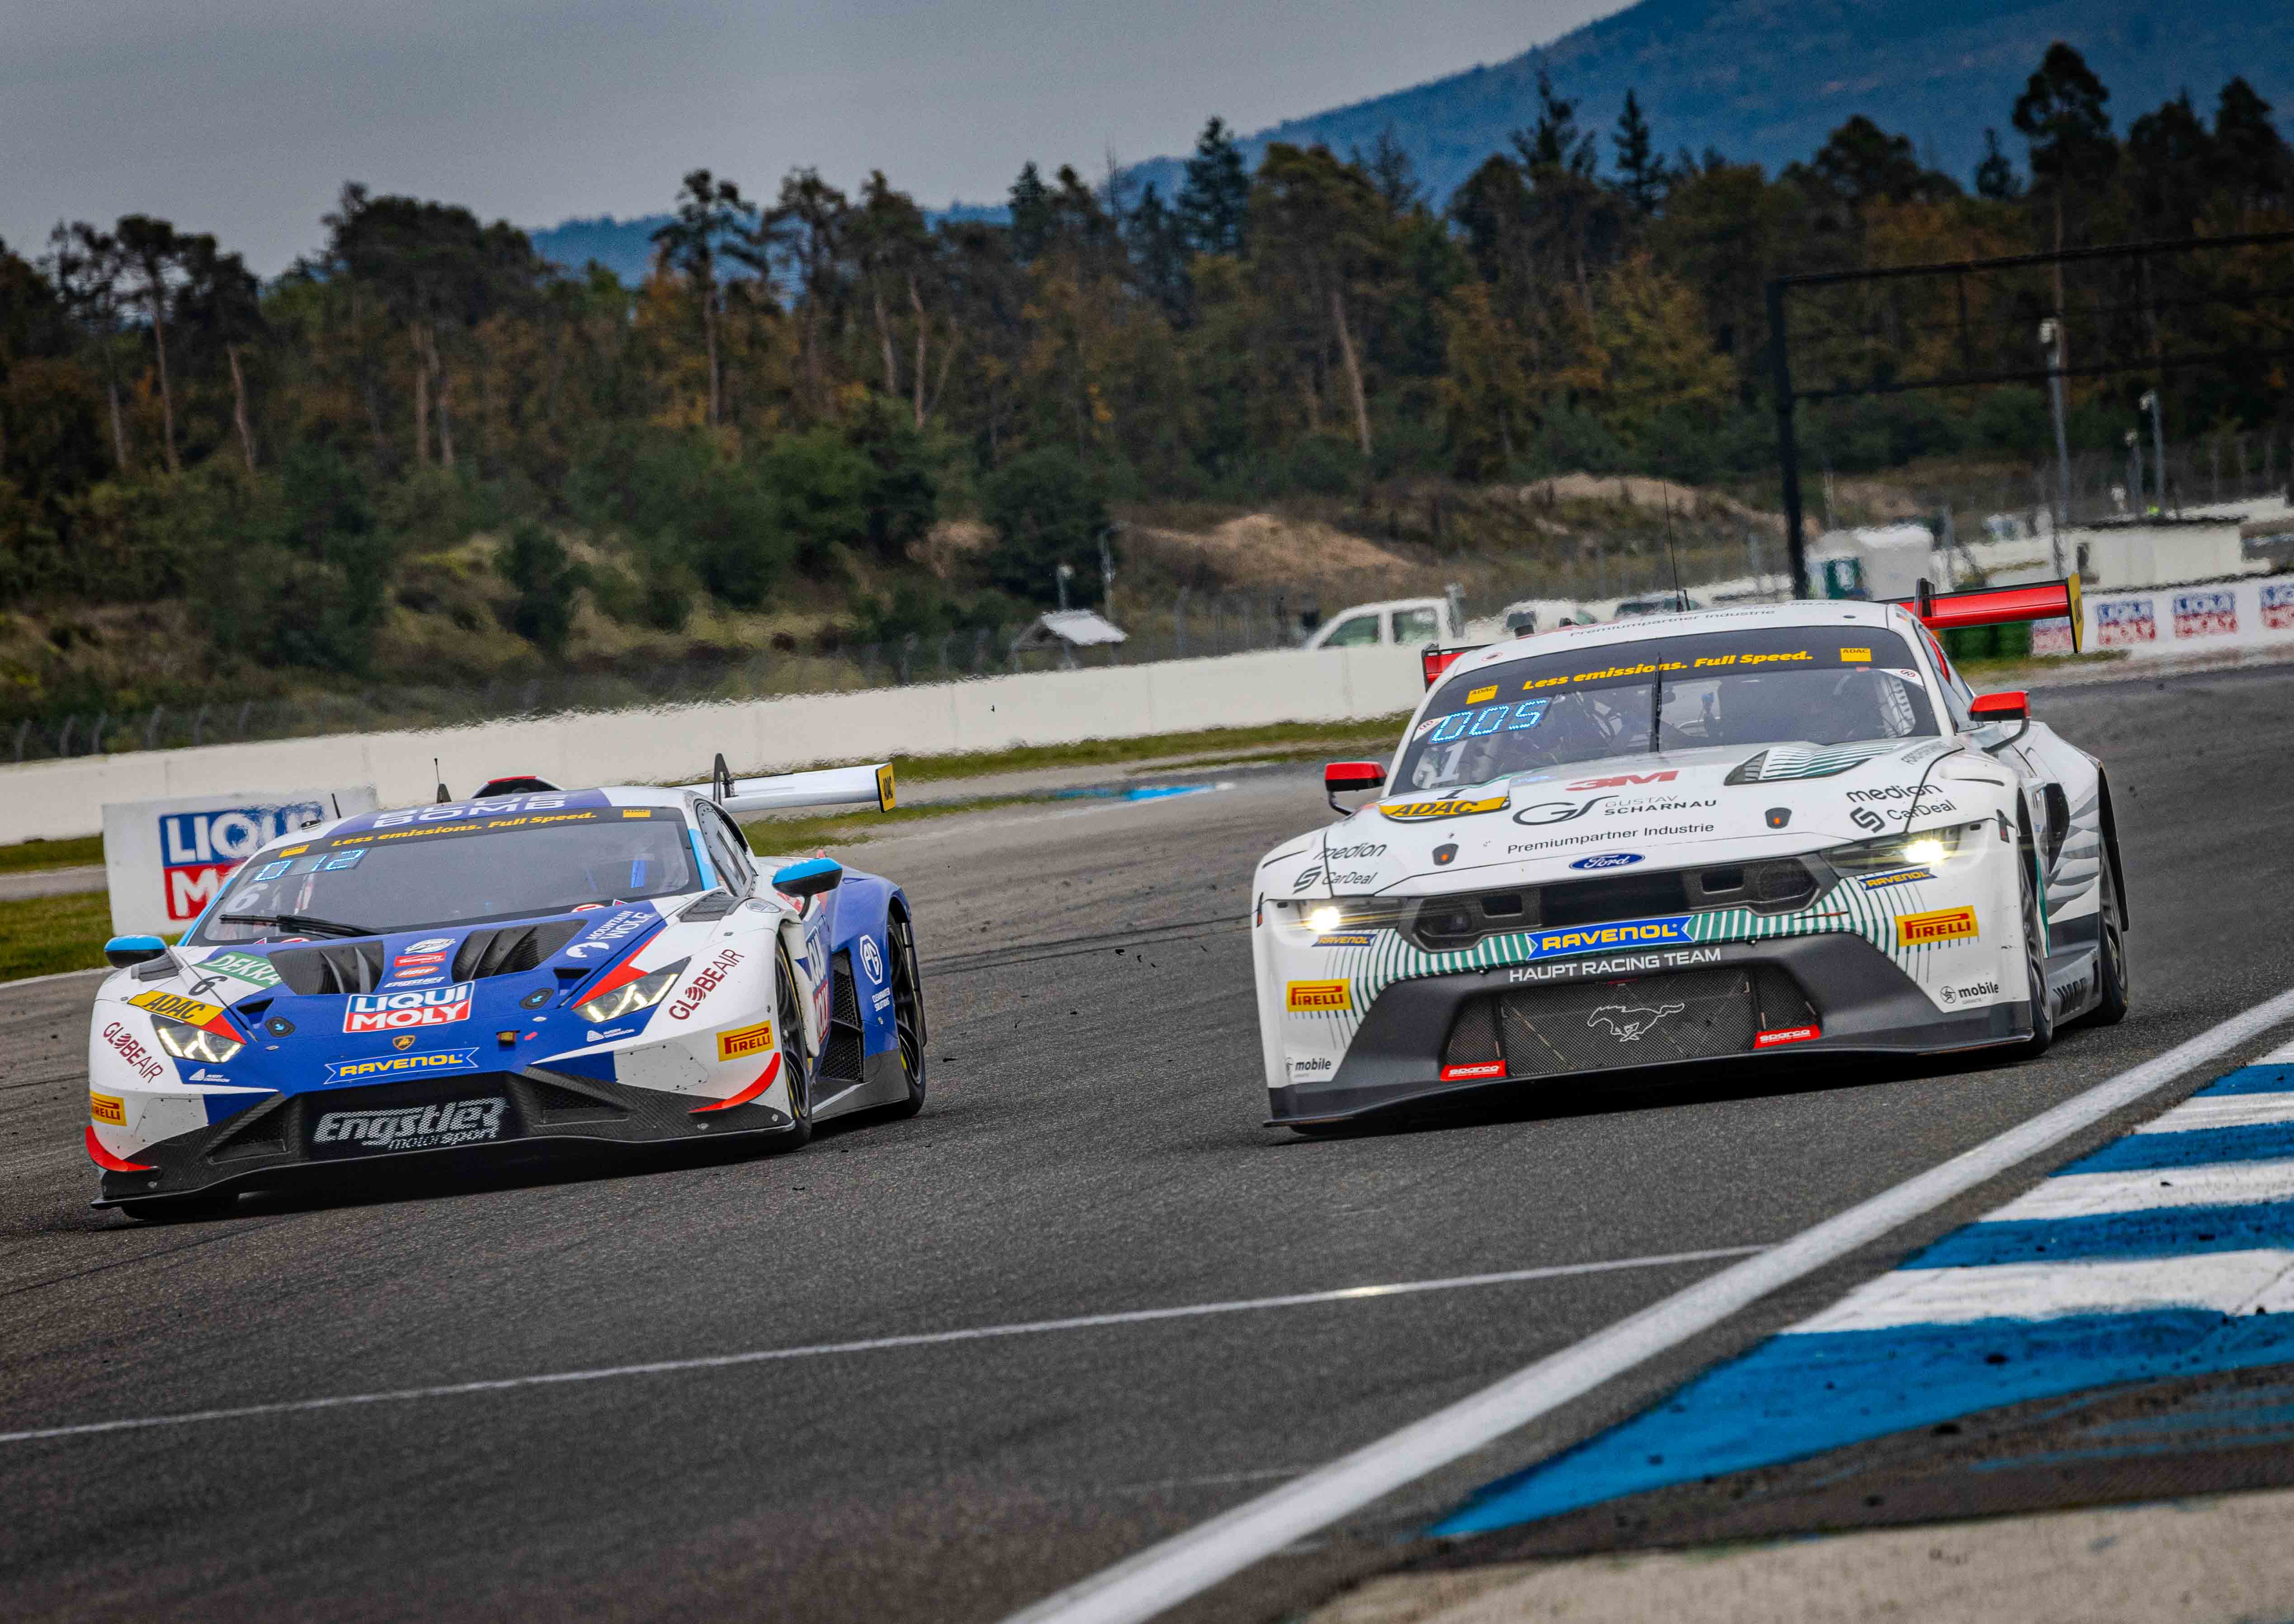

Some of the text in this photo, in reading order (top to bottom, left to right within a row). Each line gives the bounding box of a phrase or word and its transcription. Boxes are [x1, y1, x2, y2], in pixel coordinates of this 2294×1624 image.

[1523, 651, 1813, 690] Less emissions. Full Speed.
[1470, 686, 1497, 695] ADAC
[1432, 699, 1547, 743] 005
[1565, 771, 1679, 791] 3M
[1605, 795, 1679, 807] GUSTAV
[1846, 785, 1943, 803] medion
[1389, 801, 1478, 816] ADAC
[1604, 799, 1717, 815] SCHARNAU
[1887, 800, 1957, 820] CarDeal
[331, 812, 597, 847] Less emissions. Full Speed.
[1508, 823, 1715, 854] Premiumpartner Industrie
[1583, 854, 1629, 869] Ford
[1322, 872, 1378, 885] CarDeal
[1865, 871, 1930, 887] RAVENOL
[226, 883, 268, 912] 6
[586, 910, 634, 941] MOUNTAIN
[601, 912, 654, 940] WOLF
[1905, 913, 1972, 940] PIRELLI
[1542, 923, 1678, 951] RAVENOL
[203, 954, 283, 985] DEKRA
[1510, 948, 1721, 983] HAUPT RACING TEAM
[189, 976, 227, 996] 6
[1291, 986, 1344, 1006] PIRELLI
[1959, 981, 1999, 998] mobile
[143, 994, 204, 1020] ADAC
[355, 985, 466, 1013] LIQUI
[353, 1000, 468, 1030] MOLY
[725, 1027, 771, 1054] PIRELLI
[1760, 1029, 1811, 1041] sparco
[340, 1054, 463, 1076] RAVENOL
[1295, 1058, 1331, 1071] mobile
[1449, 1065, 1500, 1076] sparco
